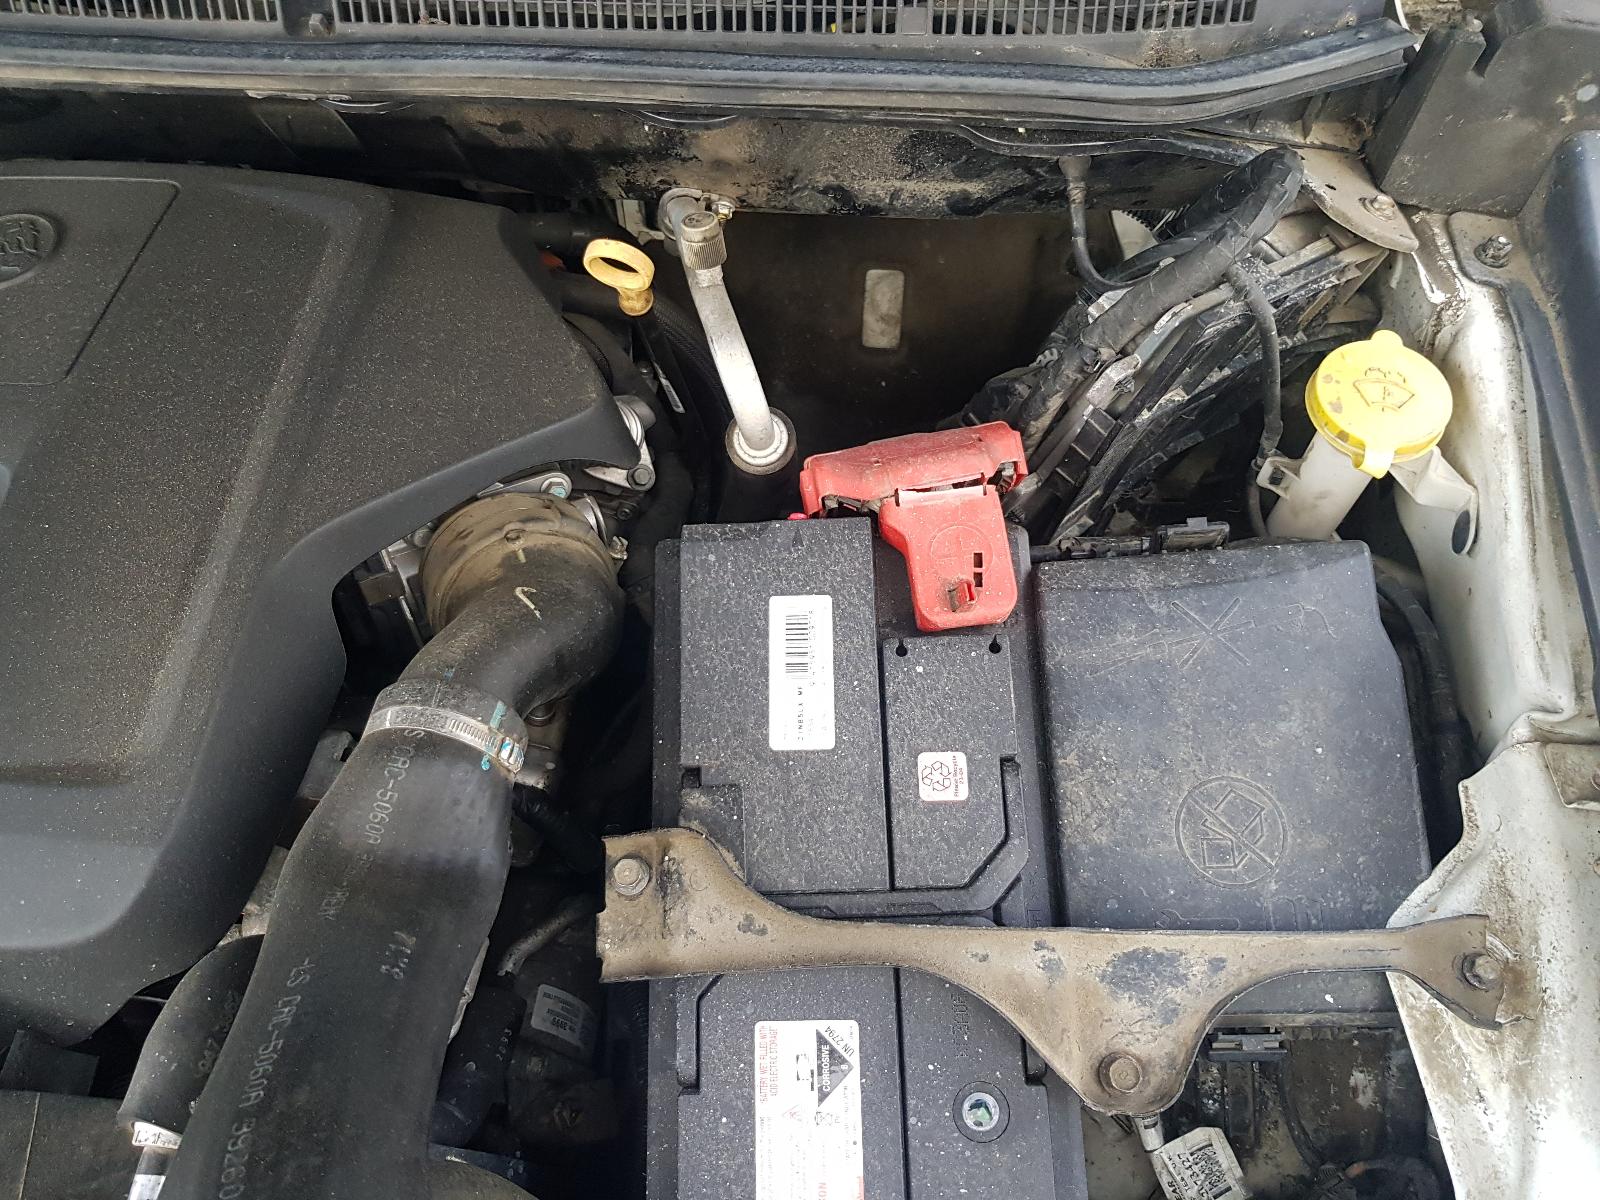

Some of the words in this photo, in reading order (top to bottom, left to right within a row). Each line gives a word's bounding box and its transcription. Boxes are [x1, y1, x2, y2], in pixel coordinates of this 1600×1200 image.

[238, 995, 302, 1109] CAC-5060A
[823, 1025, 845, 1046] 2794
[841, 1043, 855, 1057] UN
[821, 1044, 831, 1091] CORROSIVE
